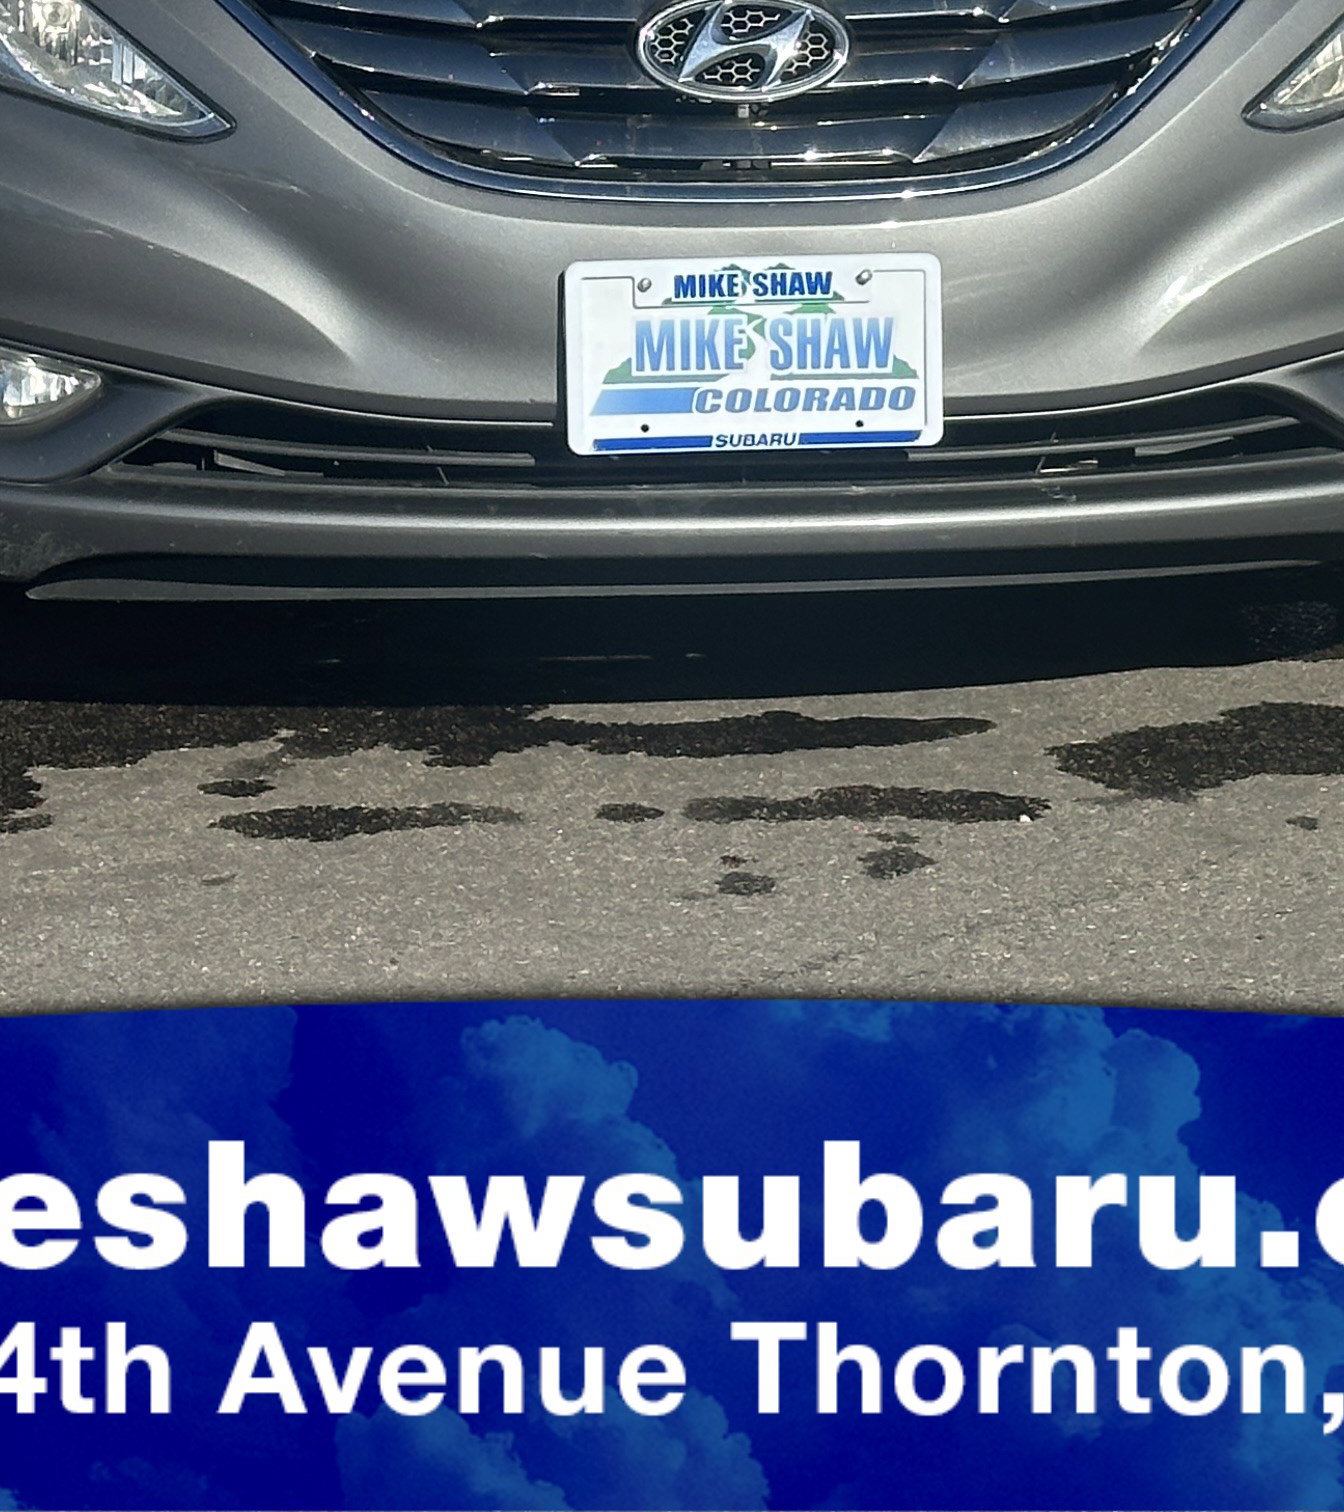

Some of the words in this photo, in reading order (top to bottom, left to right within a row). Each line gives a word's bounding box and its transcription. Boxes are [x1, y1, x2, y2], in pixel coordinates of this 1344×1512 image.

[673, 273, 739, 299] MIKE
[752, 271, 833, 297] SHAW
[635, 318, 745, 372] MIKE
[769, 317, 894, 371] SHAW
[695, 385, 916, 415] COLORADO
[715, 432, 797, 448] SUBARU
